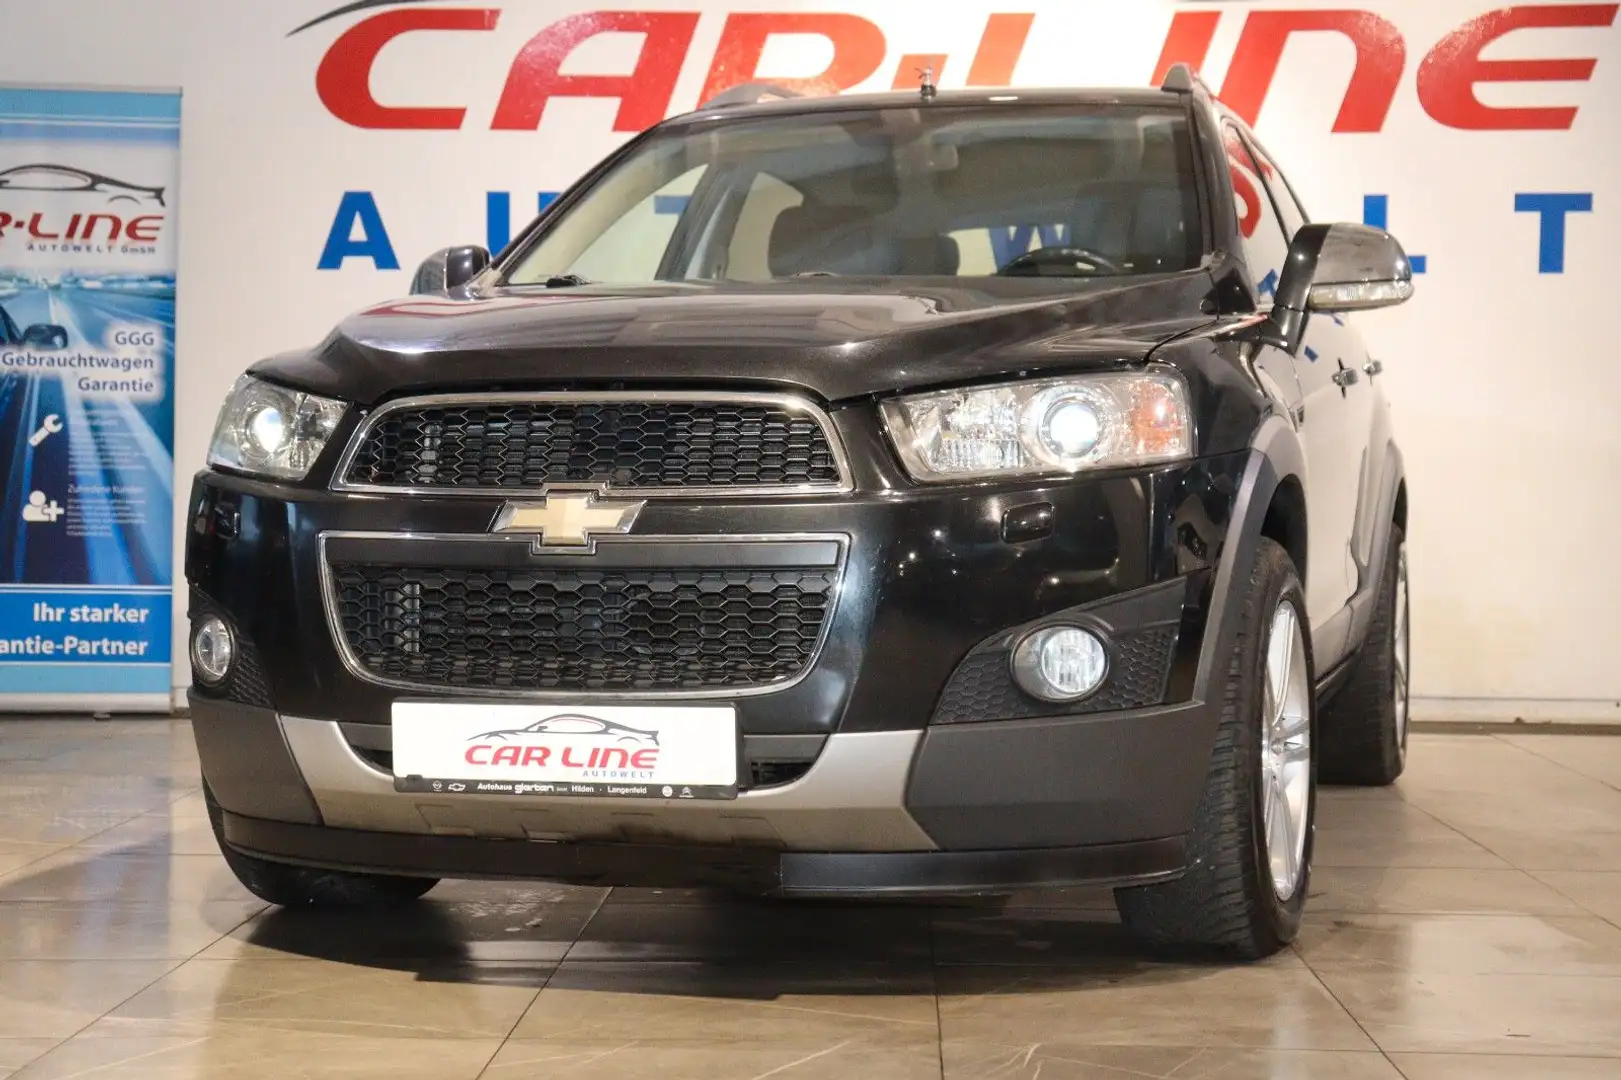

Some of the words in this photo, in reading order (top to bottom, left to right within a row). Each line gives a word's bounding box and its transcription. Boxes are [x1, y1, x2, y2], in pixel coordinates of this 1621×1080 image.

[27, 244, 113, 253] AUTOWELT
[114, 331, 155, 346] GGG
[2, 351, 154, 372] Gebrauchtwagen
[77, 376, 154, 392] Garantie
[33, 602, 66, 622] Ihr
[69, 603, 150, 623] starker
[464, 744, 551, 767] CAR
[561, 746, 660, 769] LINE
[582, 770, 655, 779] AUTOWELT
[477, 783, 513, 791] Autohaus
[571, 785, 595, 793] Hilden
